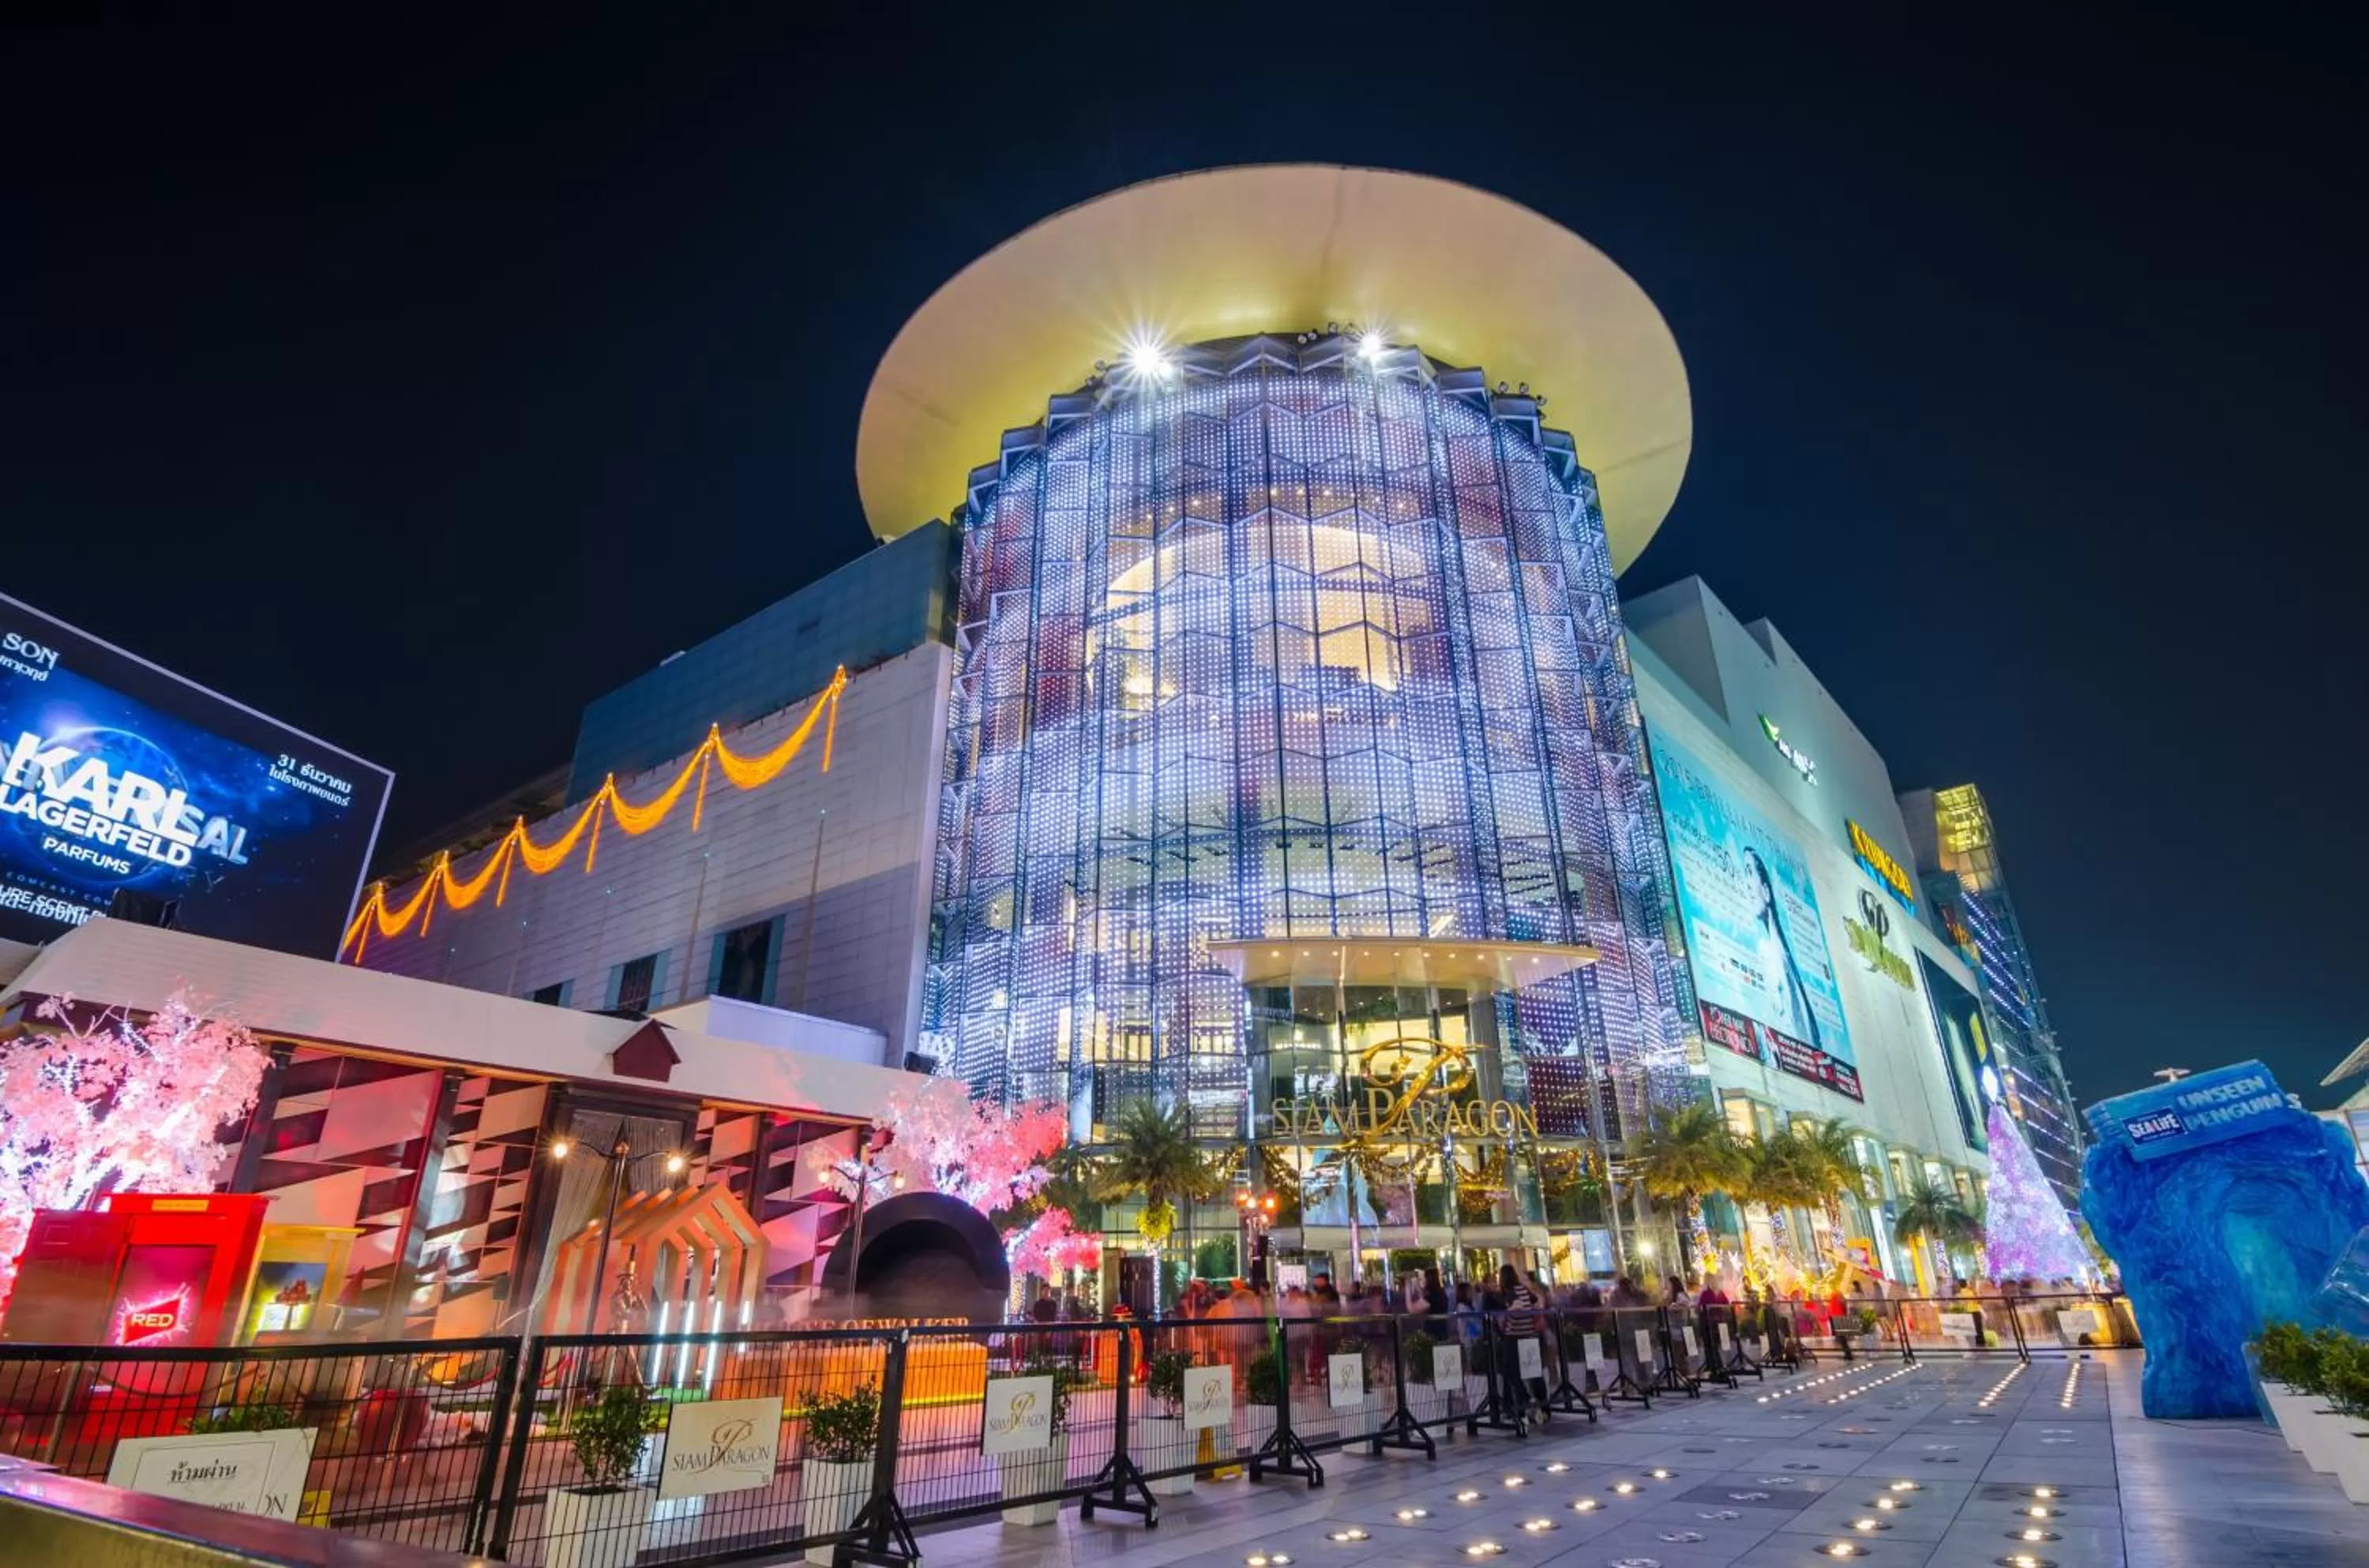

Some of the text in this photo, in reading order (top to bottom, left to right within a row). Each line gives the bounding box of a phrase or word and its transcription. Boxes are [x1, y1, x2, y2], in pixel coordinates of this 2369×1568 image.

[2, 731, 197, 848] KARL
[278, 754, 352, 793] 31 ธันวาคม
[0, 785, 193, 867] LAGERFELD
[43, 837, 131, 875] PARFUMS
[2177, 1075, 2266, 1111] UNSEEN
[1272, 1087, 1540, 1139] SIAM PARAGON
[130, 1313, 175, 1328] RED
[170, 1458, 238, 1483] ห้ามผ่าน
[672, 1452, 707, 1472] SIAM
